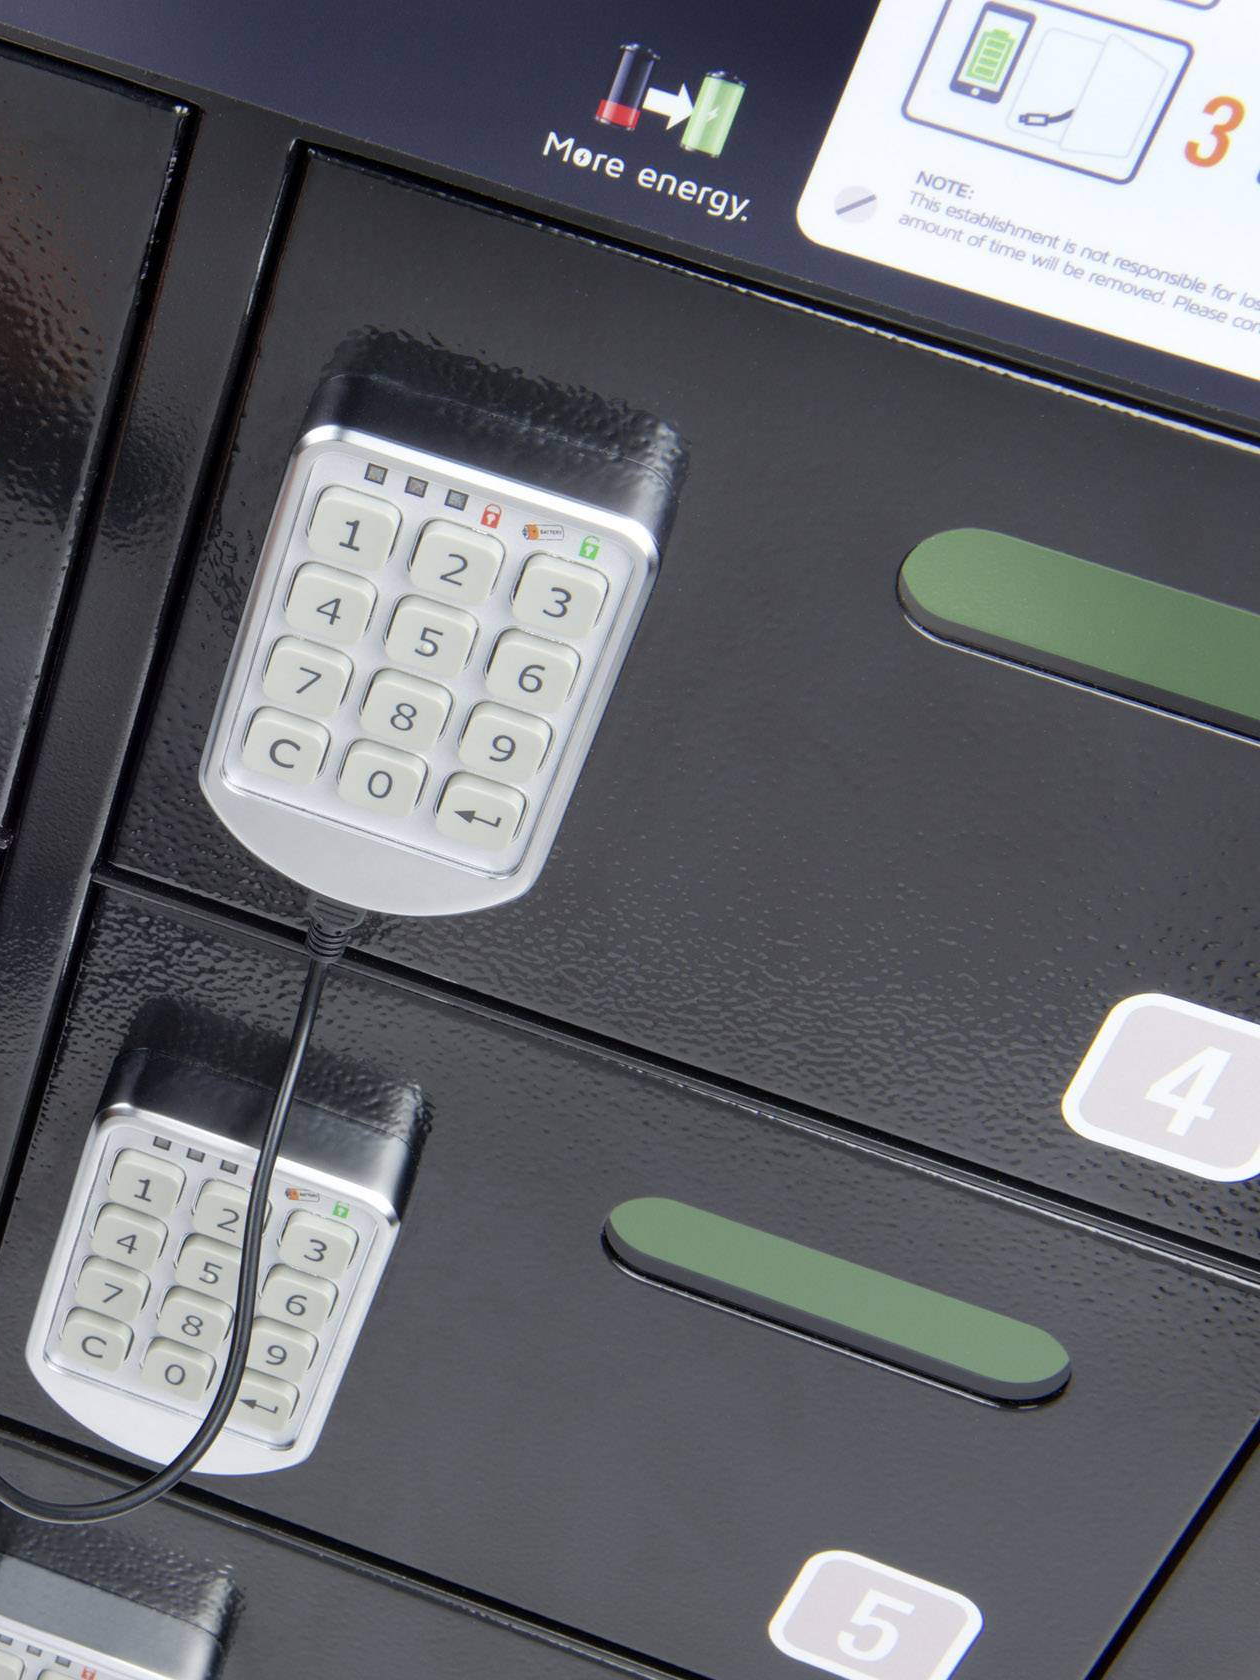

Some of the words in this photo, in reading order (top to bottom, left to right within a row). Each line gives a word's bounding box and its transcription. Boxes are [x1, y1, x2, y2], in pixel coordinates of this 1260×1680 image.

[1184, 95, 1245, 168] 3
[543, 131, 625, 178] More
[638, 167, 750, 222] energy.
[916, 171, 974, 199] NOTE:
[898, 214, 964, 242] amount
[967, 234, 989, 248] of
[988, 239, 1026, 261] time
[1032, 253, 1059, 271] will
[1063, 261, 1085, 280] be
[1088, 272, 1166, 305] removed.
[1172, 295, 1228, 323] Please
[910, 190, 941, 213] This
[946, 205, 1060, 249] establishment
[1063, 239, 1077, 254] is
[1080, 246, 1110, 265] not
[1113, 257, 1207, 295] responsible
[1211, 283, 1237, 302] for
[338, 519, 361, 552] 1
[439, 553, 469, 587] 2
[542, 586, 573, 619] 3
[315, 597, 342, 626] 4
[414, 626, 444, 658] 5
[517, 664, 546, 694] 6
[295, 666, 323, 695] 7
[389, 702, 418, 732] 8
[488, 734, 517, 763] 9
[268, 738, 301, 769] C
[367, 770, 394, 800] 0
[1144, 1046, 1232, 1136] 4
[133, 1178, 152, 1203] 1
[216, 1207, 240, 1234] 2
[303, 1238, 328, 1263] 3
[115, 1233, 138, 1255] 4
[198, 1261, 223, 1285] 5
[285, 1294, 308, 1317] 6
[80, 1335, 108, 1359] C
[164, 1363, 187, 1386] 0
[101, 1282, 124, 1304] 7
[180, 1314, 204, 1338] 8
[265, 1344, 288, 1366] 9
[837, 1589, 915, 1662] 5
